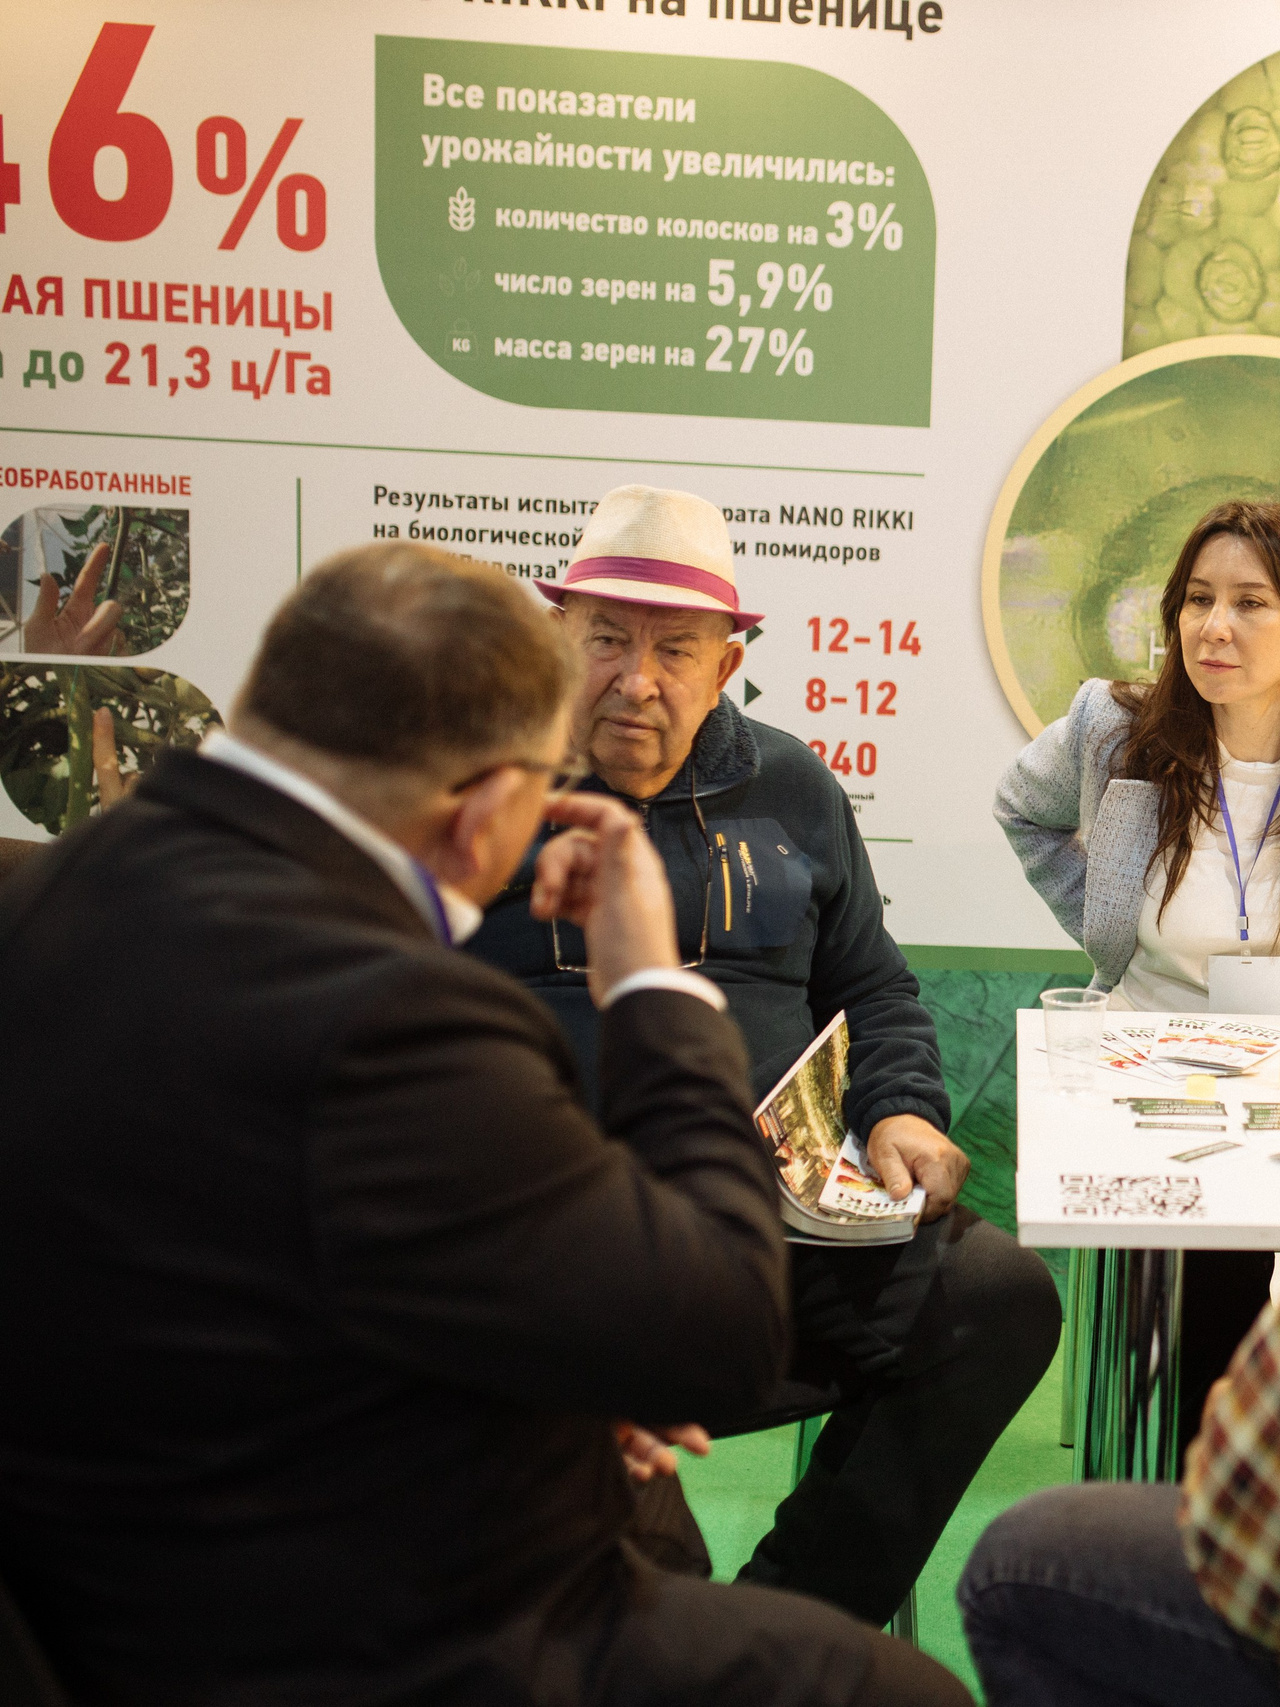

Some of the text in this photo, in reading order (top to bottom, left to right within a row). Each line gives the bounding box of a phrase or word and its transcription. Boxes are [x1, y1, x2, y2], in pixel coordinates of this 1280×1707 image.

[708, 0, 944, 41] пшенице
[423, 73, 696, 123] Все показатели
[0, 22, 327, 253] 6%
[422, 132, 896, 187] урожайности увеличились:
[495, 199, 903, 252] количество колосков на 3%
[84, 278, 333, 337] ПШЕНИЦЫ
[494, 258, 834, 317] число зерен на 5,9%
[23, 349, 85, 389] до
[105, 342, 211, 396] 21,3
[231, 348, 332, 400] ц/Га
[494, 324, 815, 378] масса зерен на 27%
[373, 485, 509, 513] Результаты
[779, 505, 844, 527] NANO
[853, 508, 914, 531] RIKKI
[373, 523, 400, 539] на
[754, 541, 881, 566] помидоров
